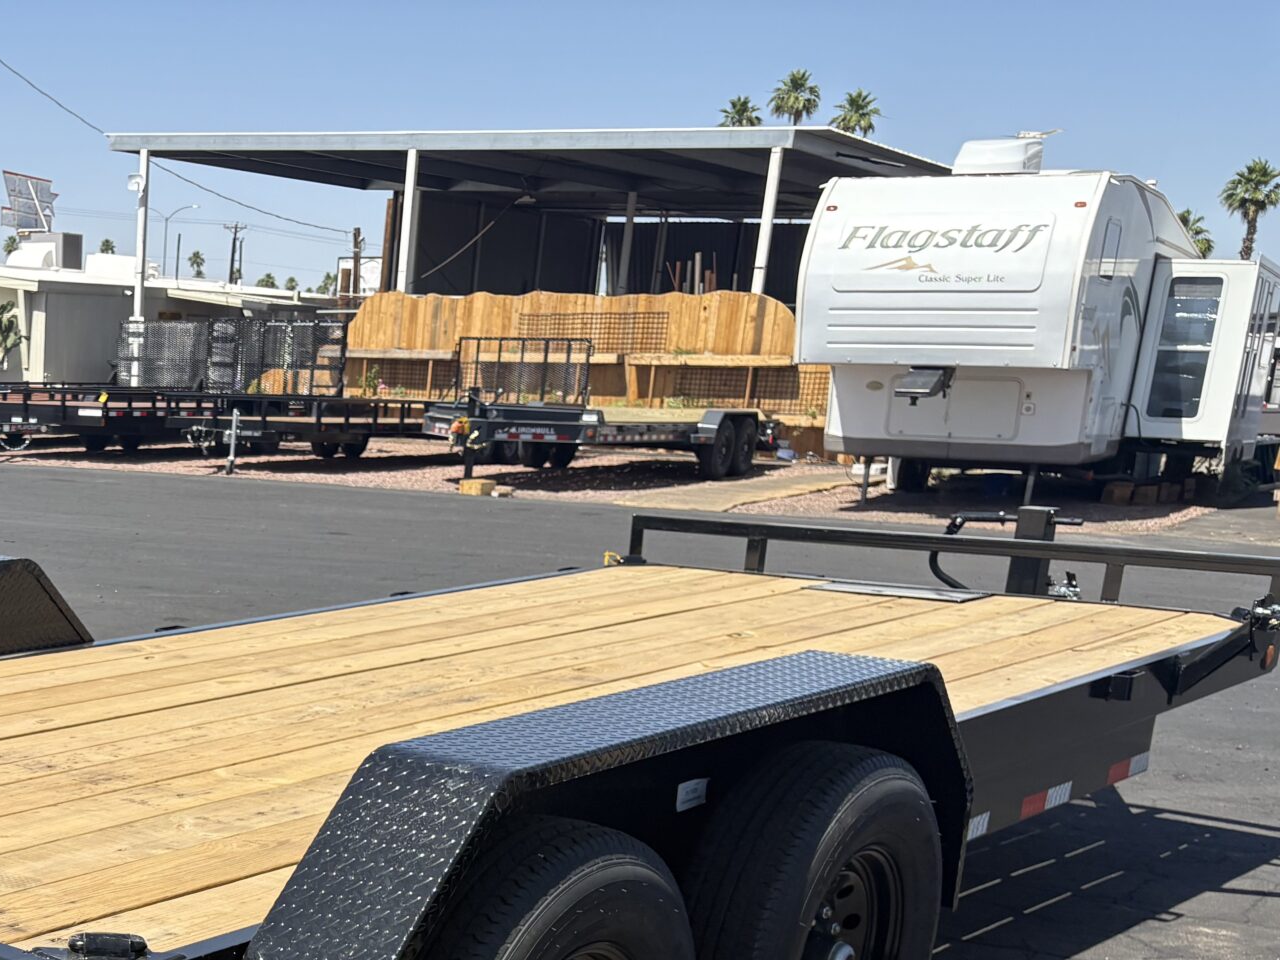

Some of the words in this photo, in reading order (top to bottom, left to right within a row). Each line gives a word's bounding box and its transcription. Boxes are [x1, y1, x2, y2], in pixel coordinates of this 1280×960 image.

[838, 223, 1050, 254] Flagstaff
[917, 273, 951, 283] Classic
[954, 274, 983, 284] Super
[986, 274, 1006, 283] Lite
